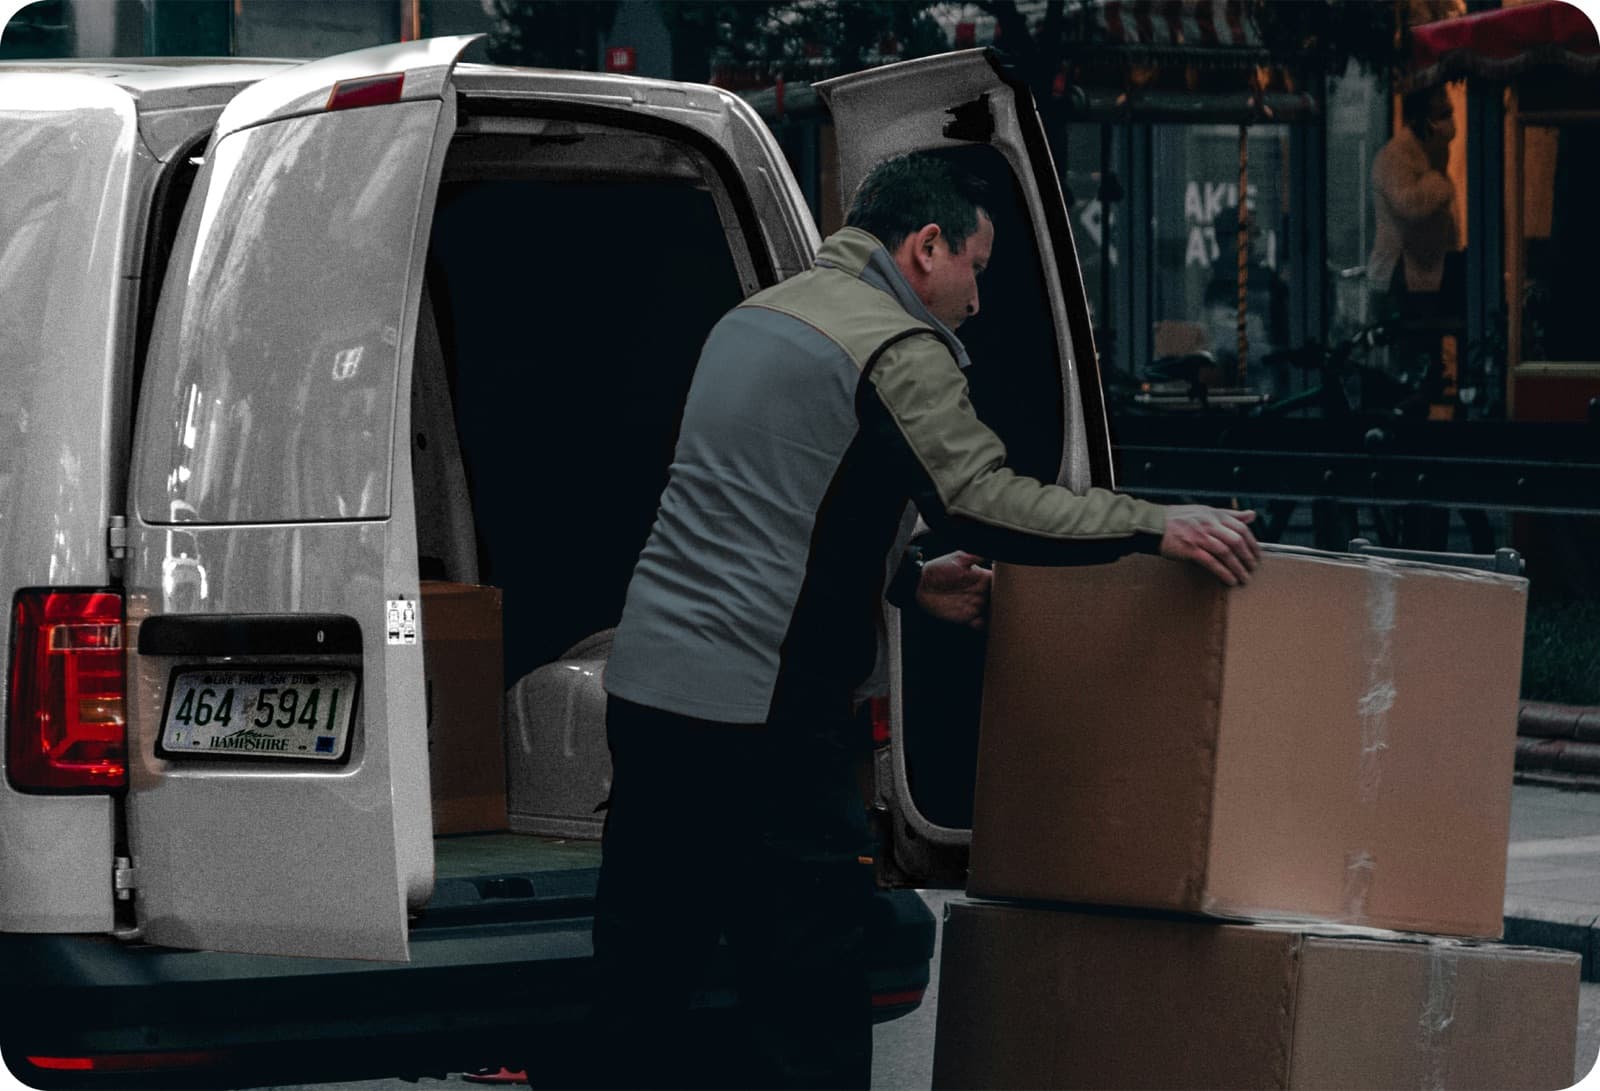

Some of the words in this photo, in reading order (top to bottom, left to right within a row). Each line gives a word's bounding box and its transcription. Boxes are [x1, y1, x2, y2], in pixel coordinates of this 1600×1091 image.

[175, 688, 234, 726] 464
[254, 688, 339, 730] 5941
[210, 736, 290, 751] HAMPSHIRE
